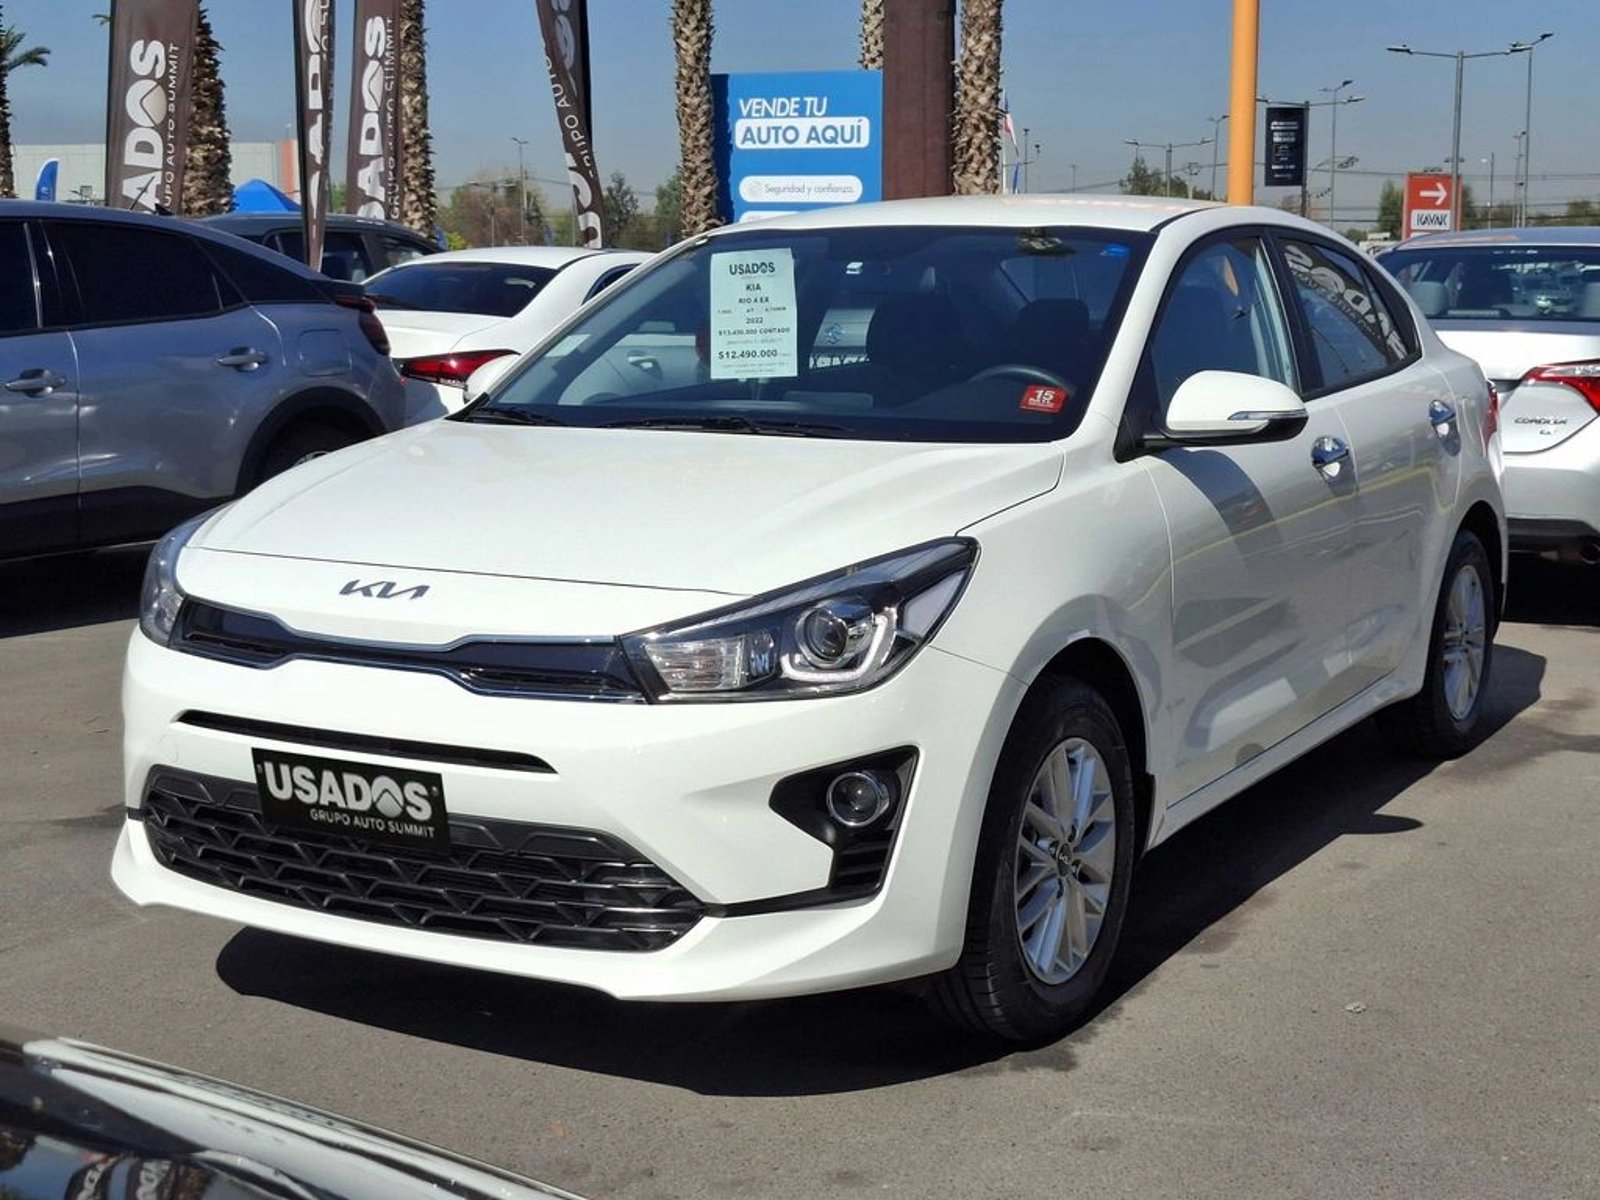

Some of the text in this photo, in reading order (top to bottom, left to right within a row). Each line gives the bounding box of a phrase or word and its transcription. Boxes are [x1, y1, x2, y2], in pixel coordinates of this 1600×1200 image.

[168, 42, 180, 112] SUMMIT
[739, 97, 828, 117] VENDE TU
[741, 119, 862, 145] AUTO AQUÍ
[166, 120, 176, 165] AUTO
[764, 181, 806, 195] Seguridad
[1416, 214, 1448, 226] KAVAK
[729, 262, 776, 275] USADOS
[746, 283, 762, 291] KIA
[718, 349, 777, 360] $12.490.000
[263, 761, 433, 821] USADOS
[310, 808, 435, 838] GRUPO AUTO SUMMIT
